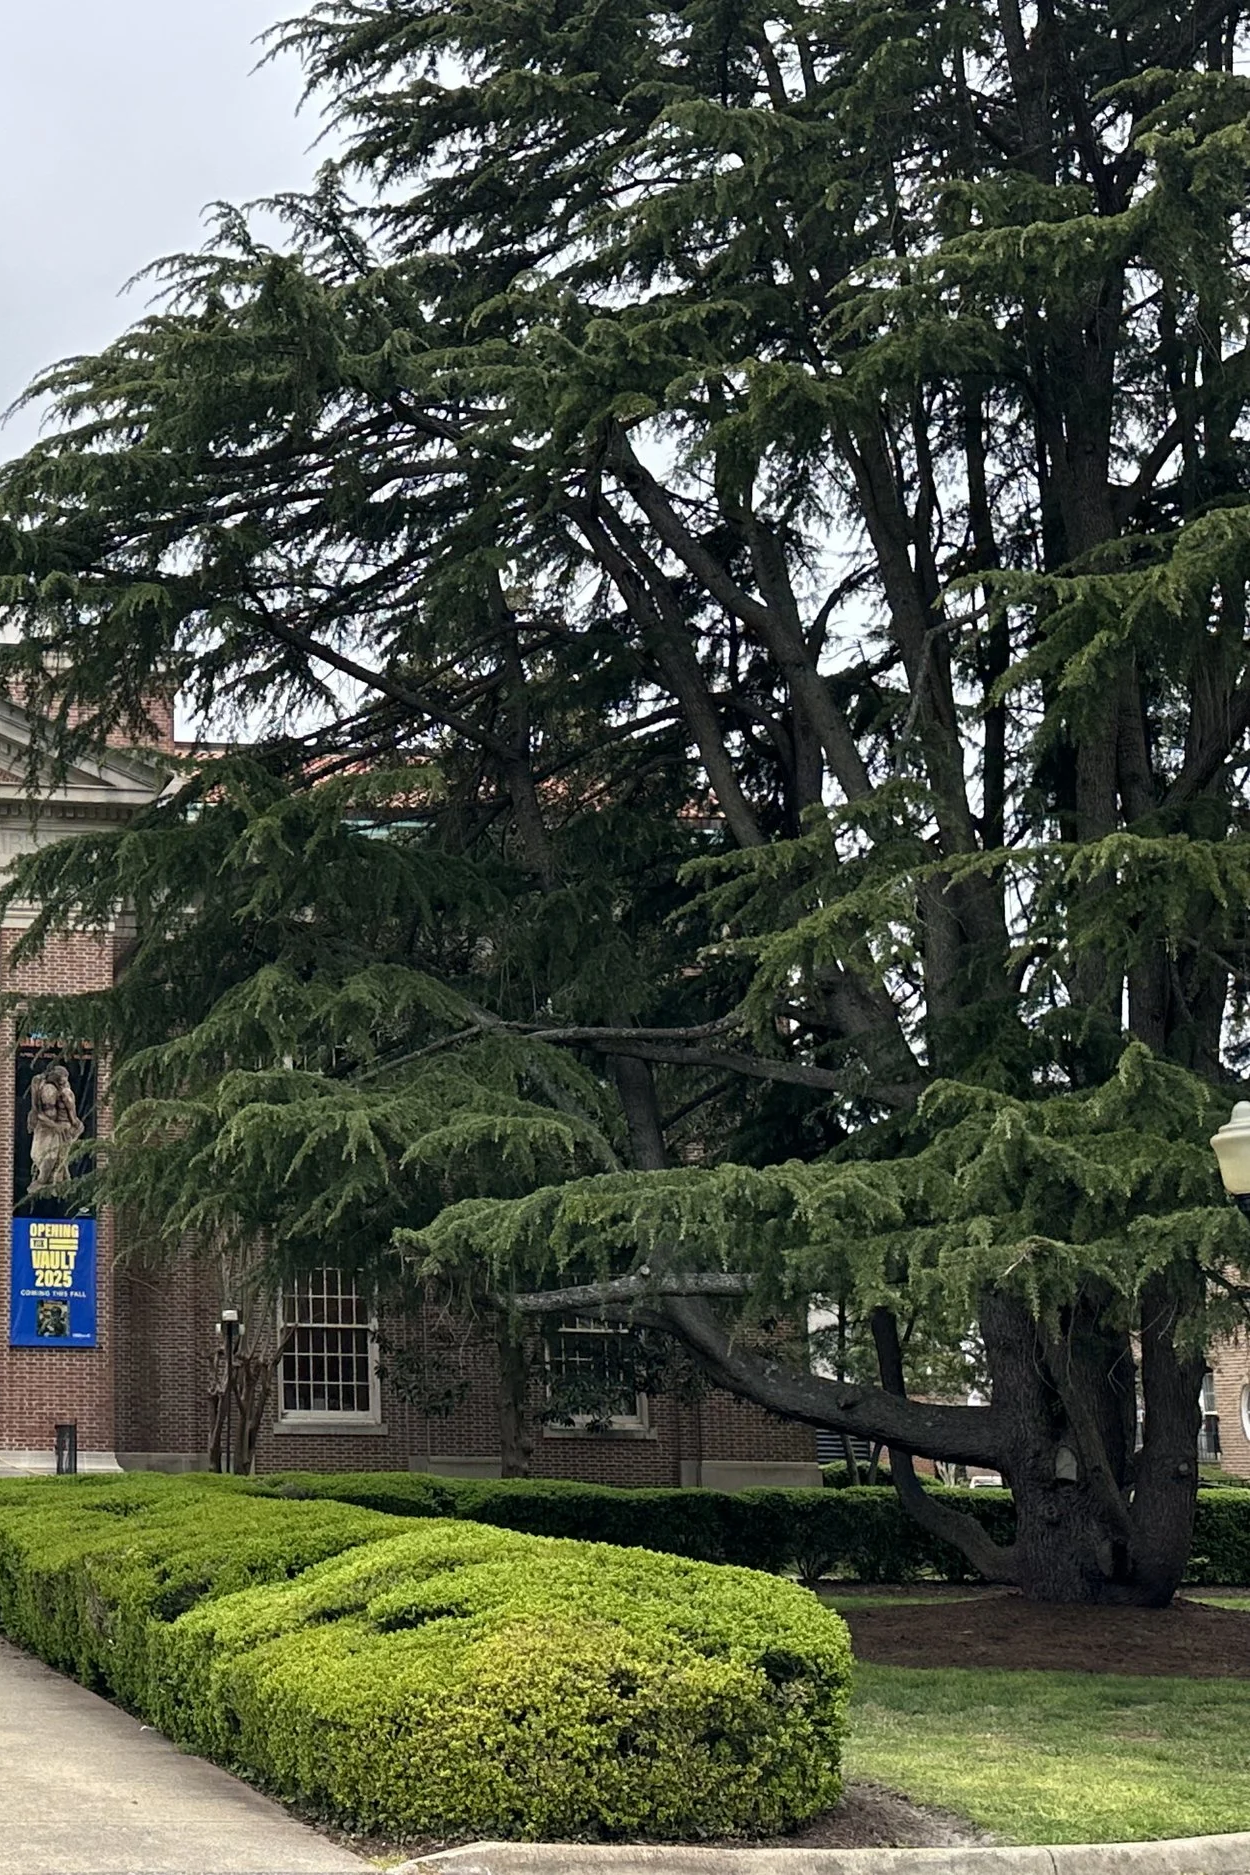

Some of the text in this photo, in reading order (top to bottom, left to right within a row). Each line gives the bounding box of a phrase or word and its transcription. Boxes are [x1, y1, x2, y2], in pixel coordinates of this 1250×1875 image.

[30, 1223, 79, 1238] OPENING
[31, 1250, 77, 1270] VAULT
[35, 1270, 72, 1288] 2025
[20, 1289, 51, 1297] COMING
[69, 1290, 87, 1298] FALL
